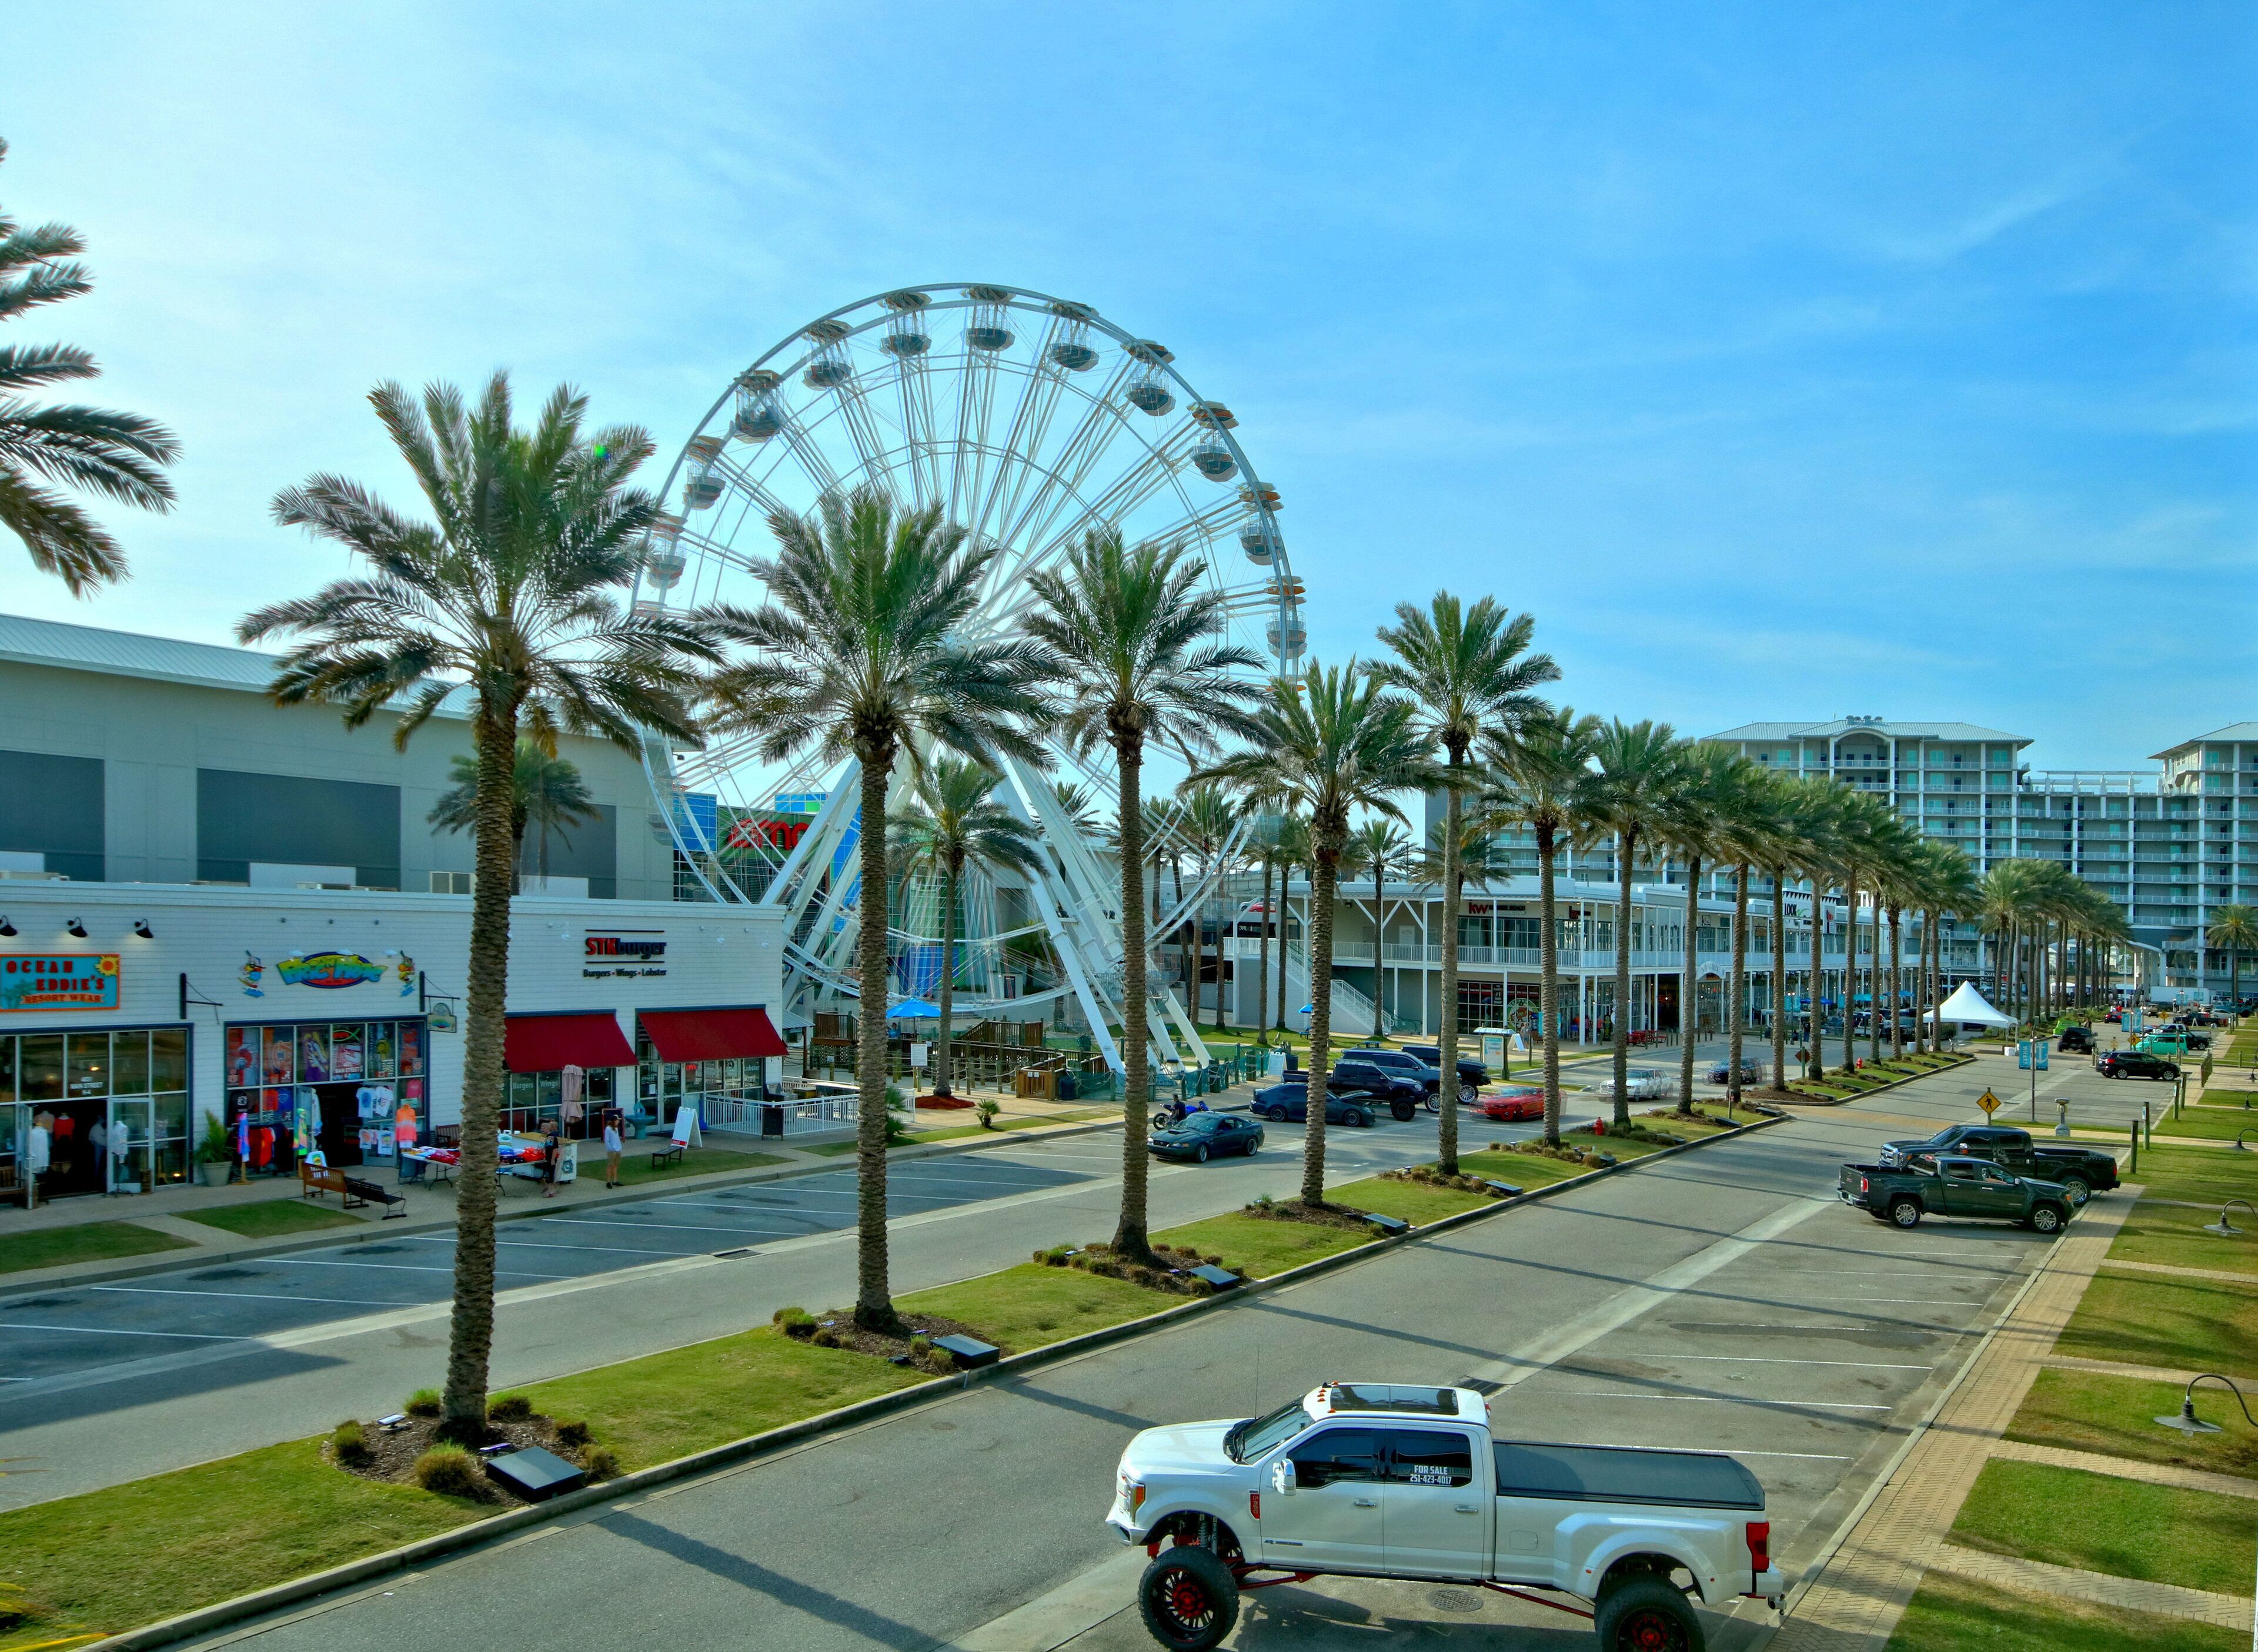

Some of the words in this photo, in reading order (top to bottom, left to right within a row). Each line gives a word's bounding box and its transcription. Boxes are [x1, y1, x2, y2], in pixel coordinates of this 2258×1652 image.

[1469, 902, 1488, 914] kw
[1785, 903, 1797, 916] LOOK
[6, 961, 73, 973] OCEAN
[583, 969, 611, 979] Burgers
[616, 968, 637, 978] Wings
[36, 975, 105, 991] EDDIE'S
[24, 994, 65, 1004] RESORT
[69, 994, 101, 1002] WEAR
[512, 1082, 534, 1091] Burgers
[540, 1080, 558, 1088] Wings
[1414, 1465, 1429, 1474] FOR
[1429, 1466, 1448, 1475] SALE
[1410, 1473, 1452, 1484] 251-423-4017
